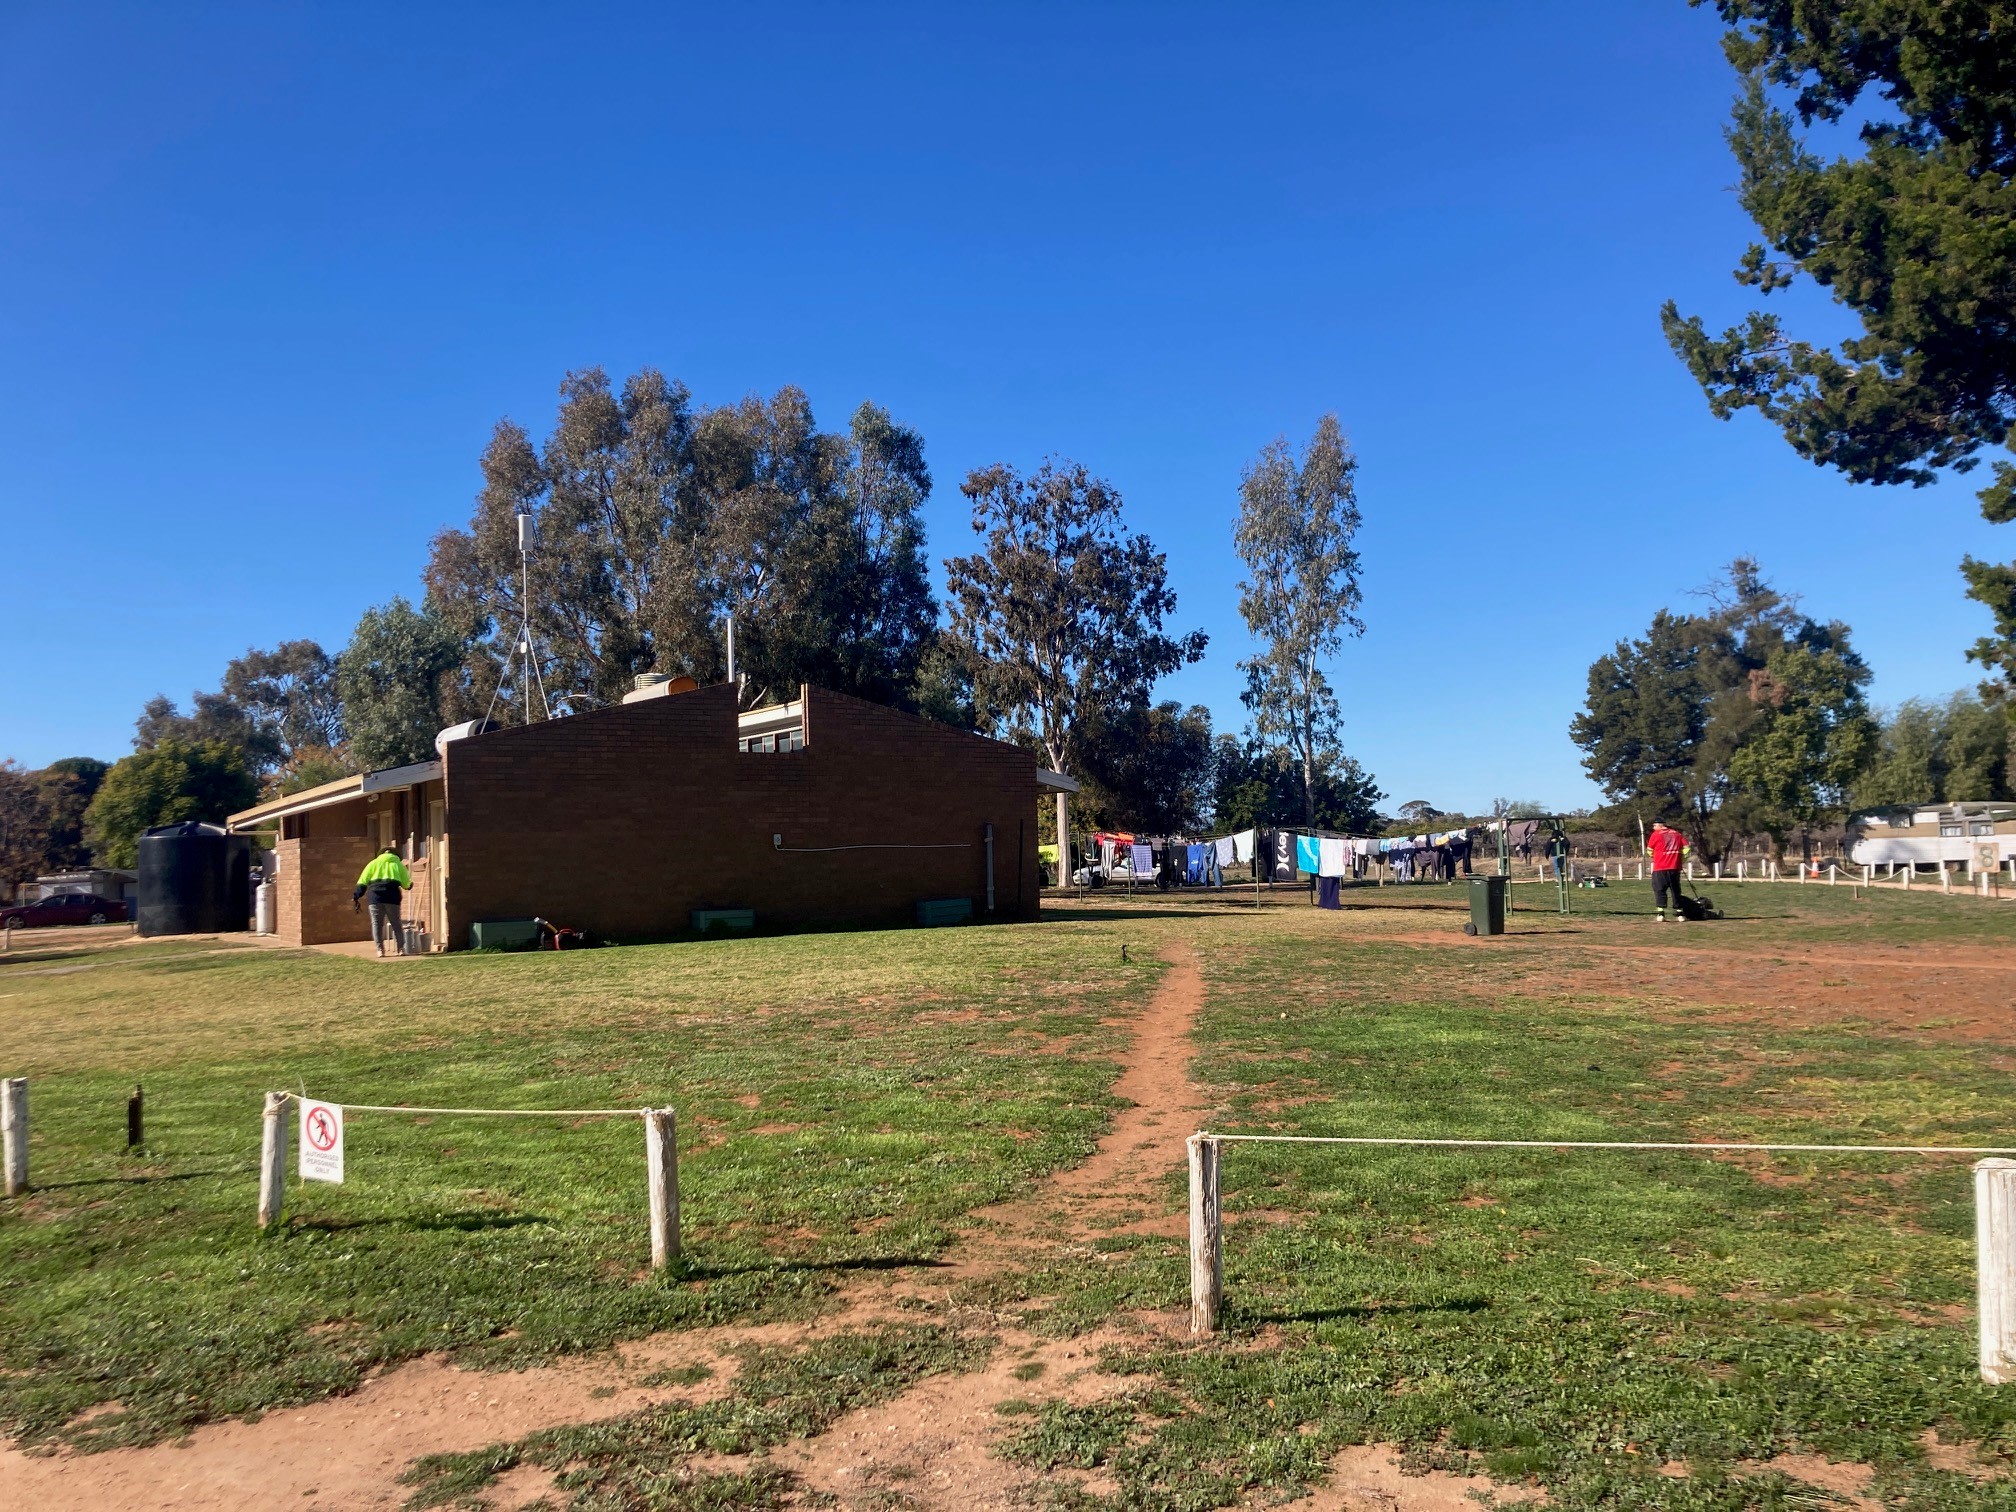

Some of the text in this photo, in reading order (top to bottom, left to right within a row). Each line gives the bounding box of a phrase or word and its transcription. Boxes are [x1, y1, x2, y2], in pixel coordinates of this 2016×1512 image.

[1278, 832, 1289, 854] ley
[1980, 847, 1993, 867] 8
[305, 1151, 338, 1161] AUTHORISED
[306, 1158, 338, 1168] PERSONNEL
